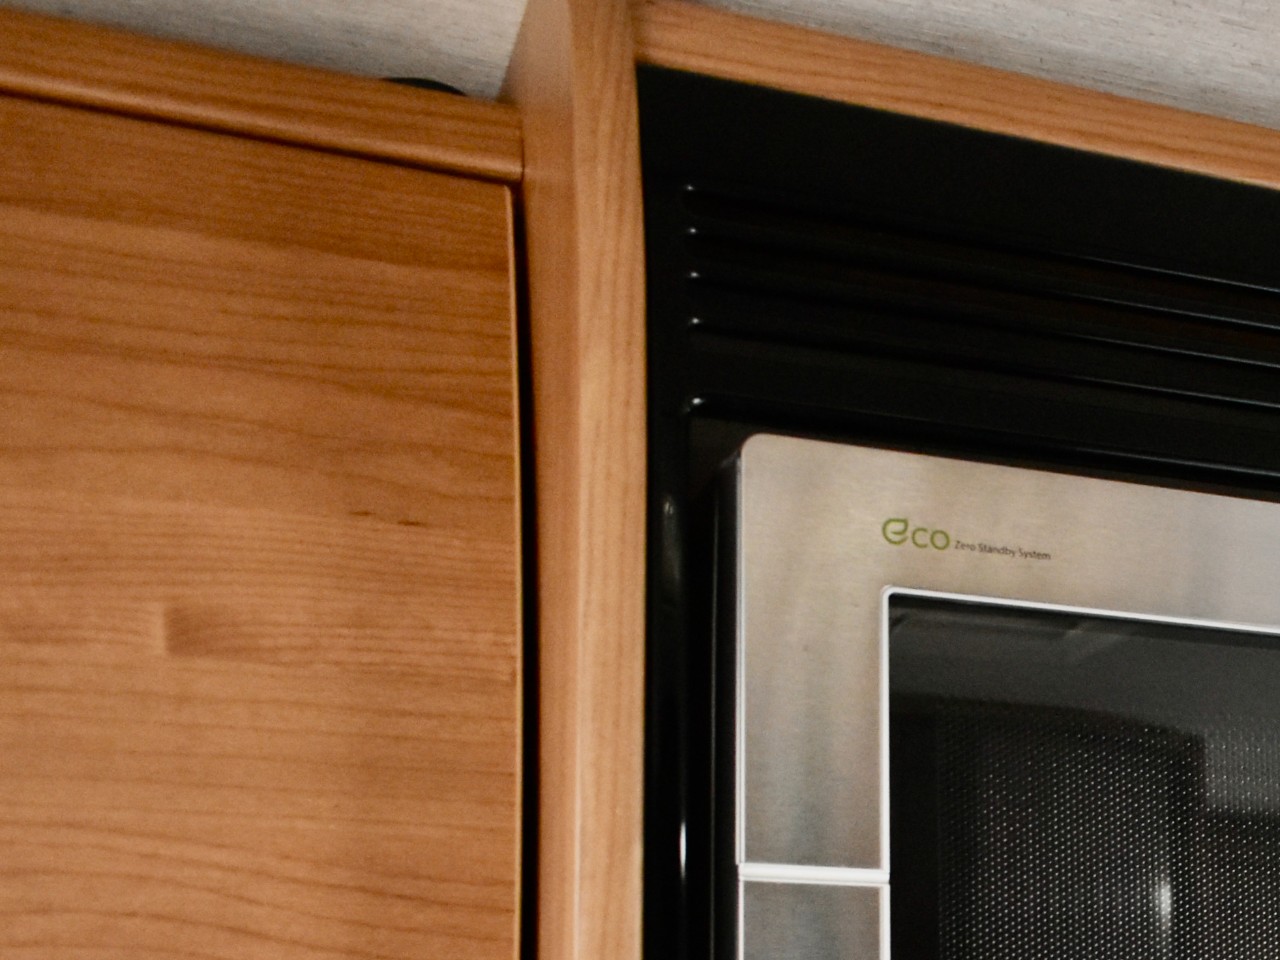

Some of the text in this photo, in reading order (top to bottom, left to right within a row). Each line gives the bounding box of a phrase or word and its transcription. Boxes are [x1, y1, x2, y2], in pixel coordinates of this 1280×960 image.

[954, 540, 976, 551] Zero
[977, 543, 1016, 557] Standby
[1018, 547, 1051, 560] System
